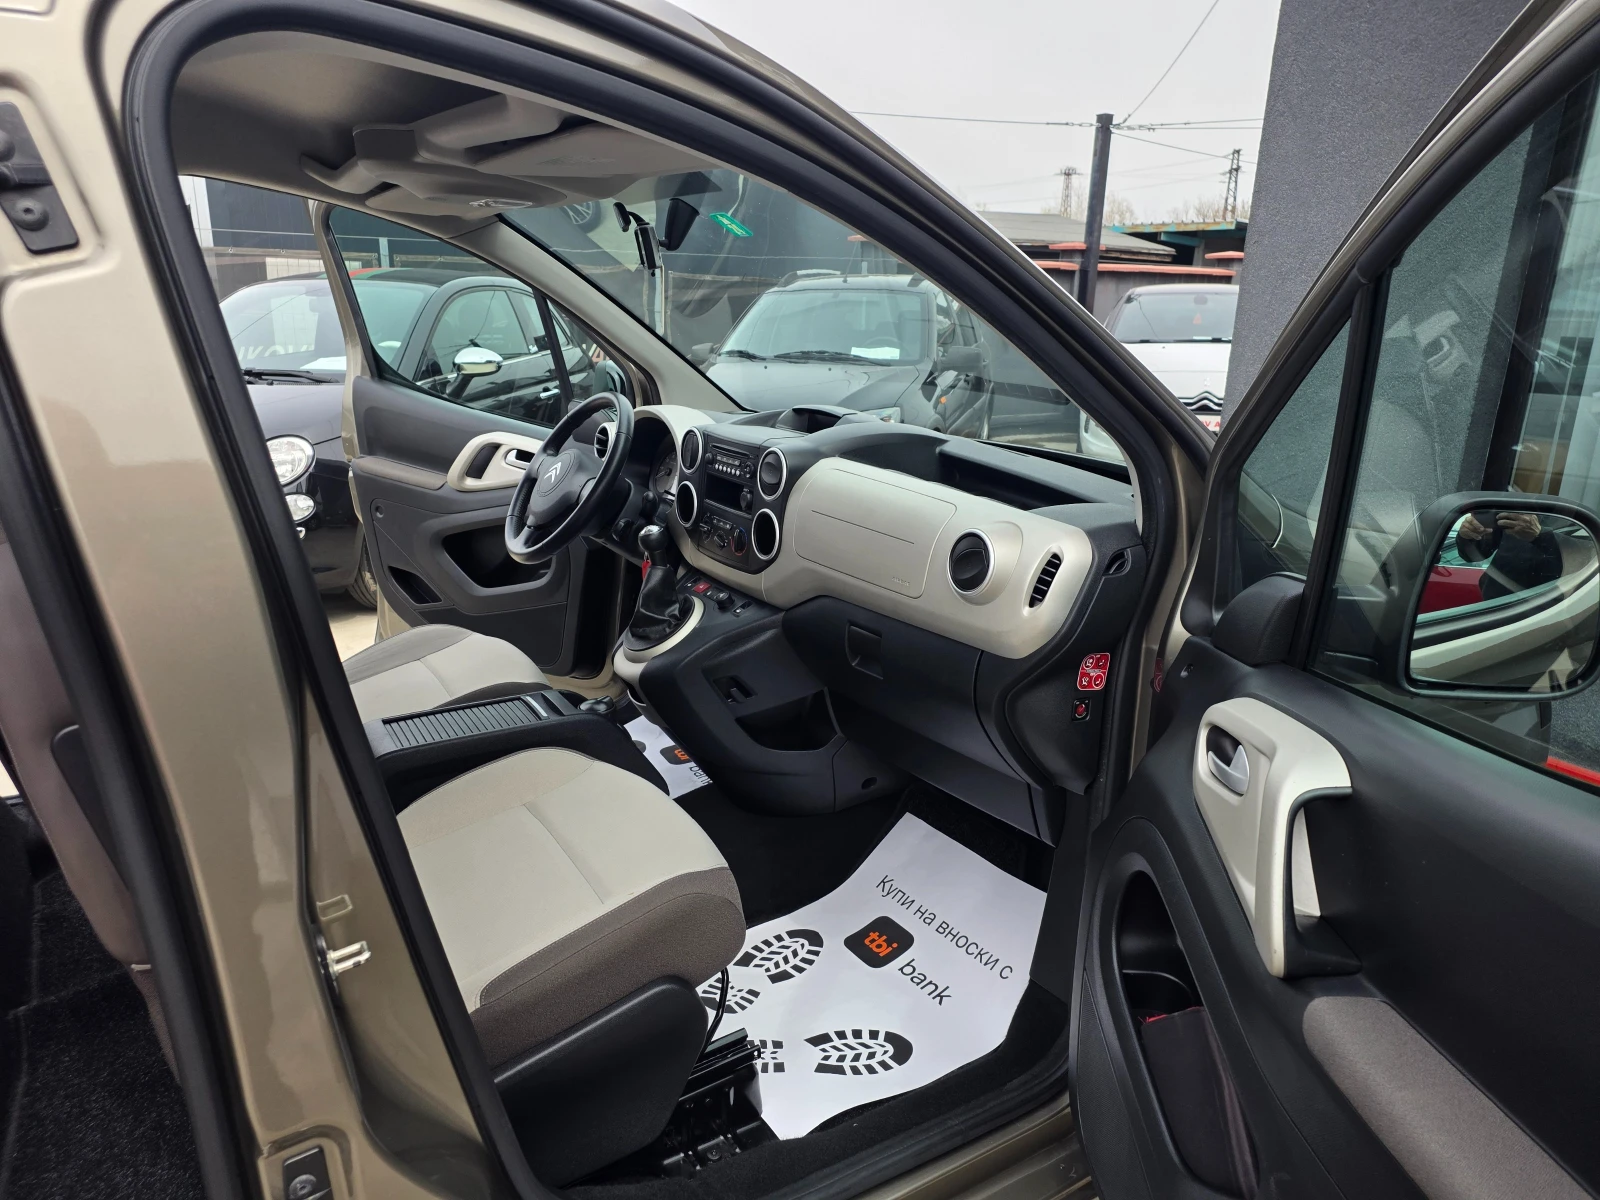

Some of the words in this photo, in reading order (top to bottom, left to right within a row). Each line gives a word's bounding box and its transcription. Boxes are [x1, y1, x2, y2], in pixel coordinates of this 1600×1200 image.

[864, 931, 899, 957] tbi
[875, 874, 916, 911] Купи
[913, 904, 937, 927] на
[935, 920, 1001, 971] вноски
[999, 965, 1014, 980] с
[897, 958, 952, 1006] bank
